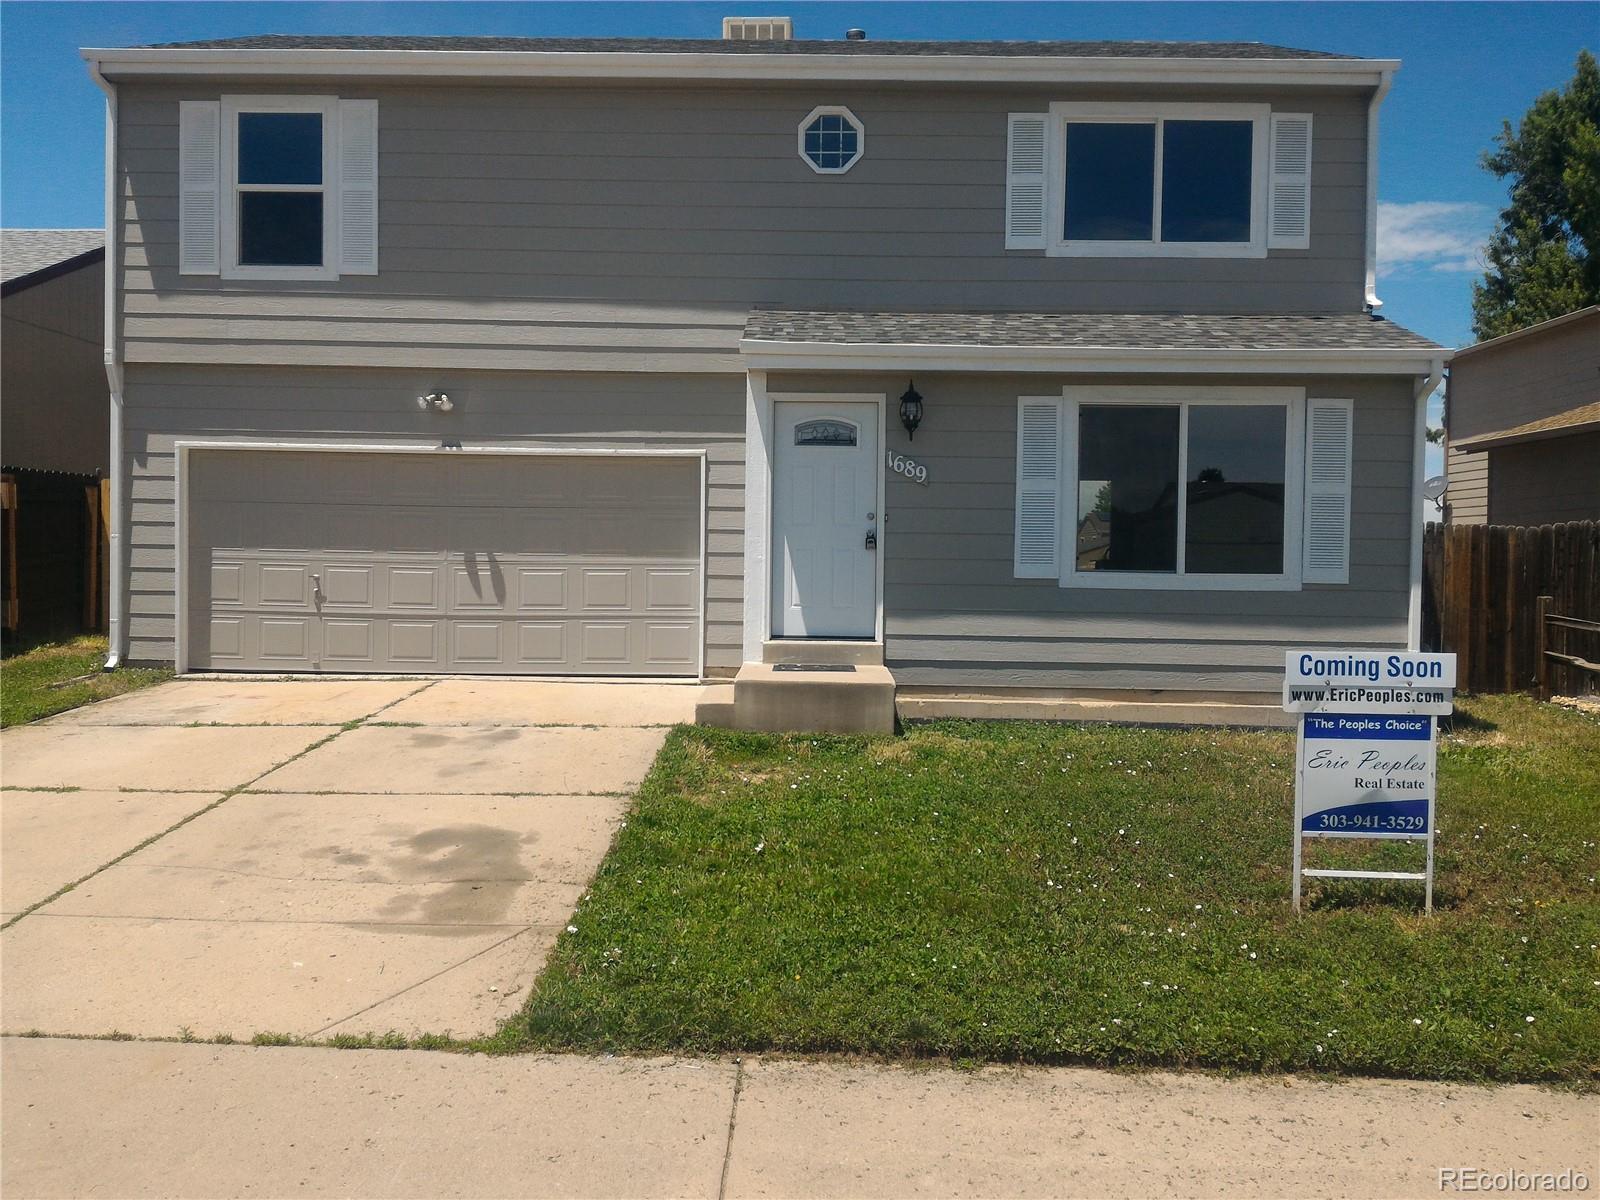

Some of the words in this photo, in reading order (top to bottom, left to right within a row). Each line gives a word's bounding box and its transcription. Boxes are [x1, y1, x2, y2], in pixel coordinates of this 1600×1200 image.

[888, 450, 927, 483] 1689
[1300, 654, 1380, 682] Coming
[1387, 655, 1442, 678] Soon
[1291, 688, 1444, 704] www.EricPeoples.com
[1339, 719, 1381, 732] Peoples
[1307, 749, 1350, 770] Eric
[1357, 750, 1427, 777] Peoples
[1354, 777, 1383, 789] Real
[1386, 778, 1425, 790] Estate
[1319, 814, 1425, 830] 303-941-3529
